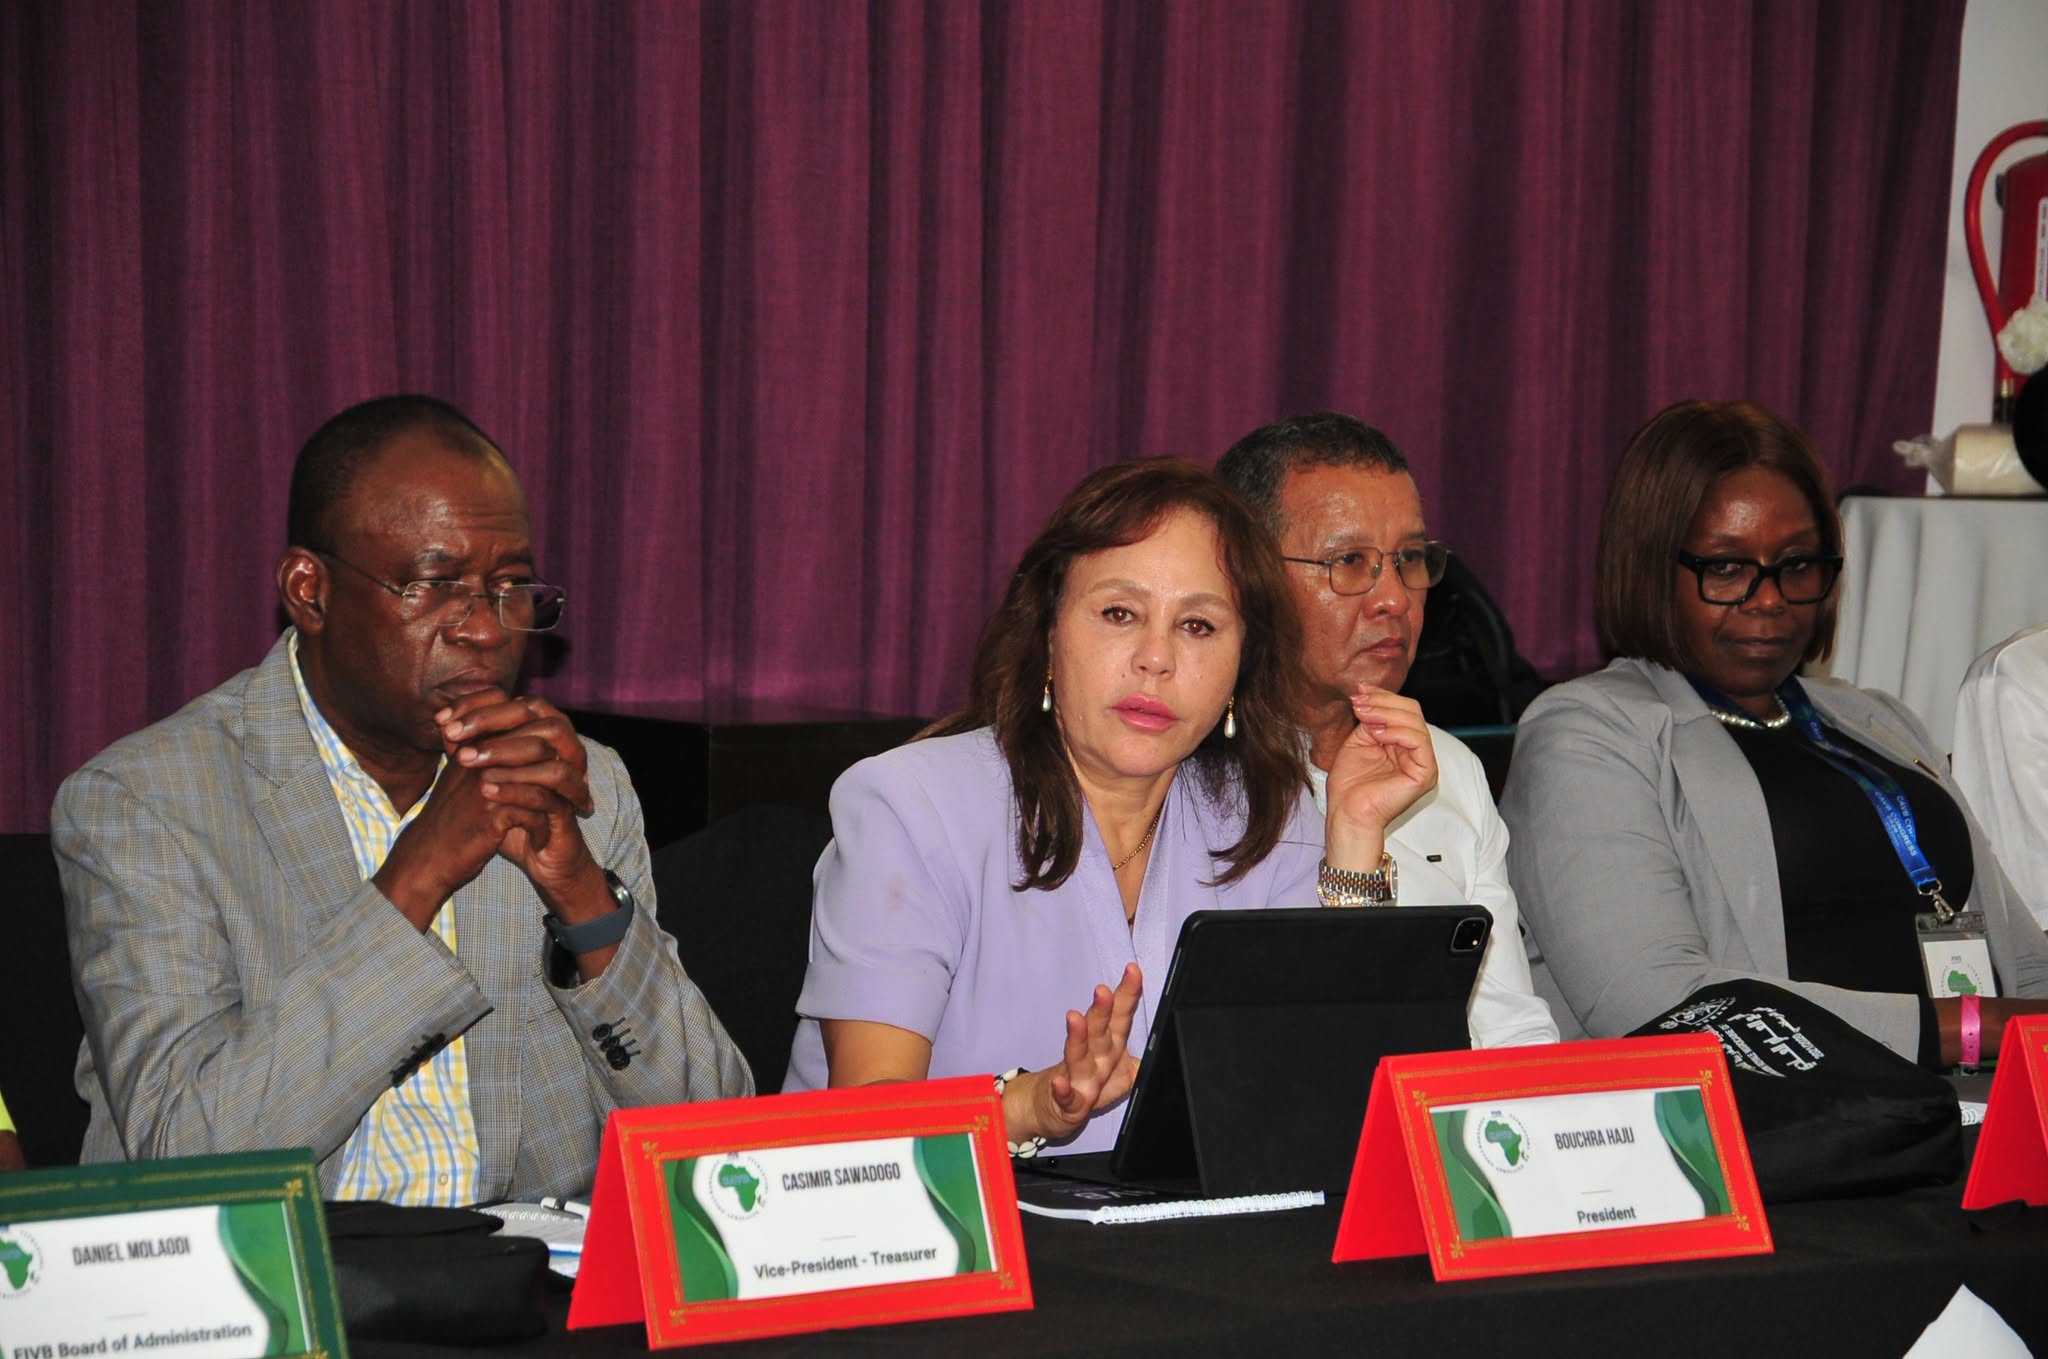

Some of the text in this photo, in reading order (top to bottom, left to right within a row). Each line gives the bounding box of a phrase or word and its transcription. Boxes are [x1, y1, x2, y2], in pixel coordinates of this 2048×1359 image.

[1889, 812, 1918, 856] CONGRESS
[1553, 1129, 1605, 1150] BOUCHRA
[782, 1162, 900, 1191] CASIMIR SAWADOGO
[1577, 1206, 1636, 1224] President
[72, 1236, 190, 1266] DANIEL MOLAODI
[753, 1254, 858, 1279] Vice-President
[871, 1247, 937, 1266] Treasurer
[14, 1323, 252, 1359] FIVB Board of Administration
